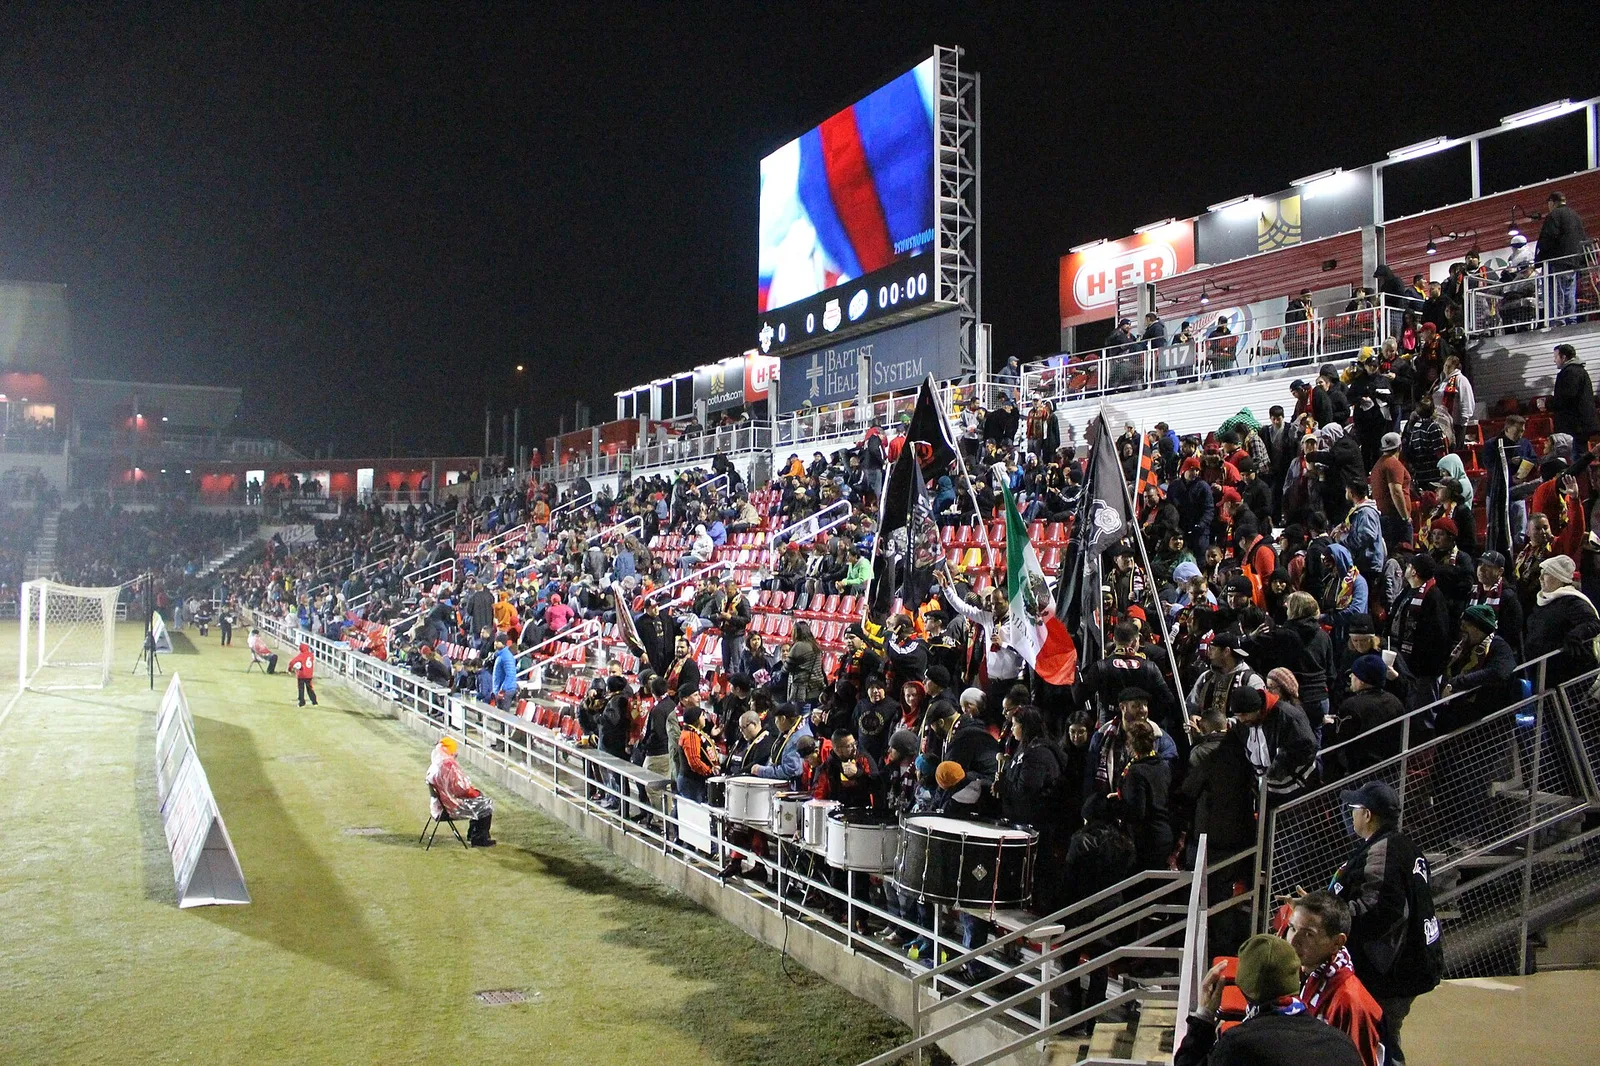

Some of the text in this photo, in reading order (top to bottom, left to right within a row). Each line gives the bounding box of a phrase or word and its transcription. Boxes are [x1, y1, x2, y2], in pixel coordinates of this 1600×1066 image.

[777, 272, 928, 343] 0 0 00:00
[1163, 345, 1190, 367] 117
[874, 357, 923, 386] SYSTEM
[857, 404, 872, 419] 116
[305, 656, 313, 669] 6
